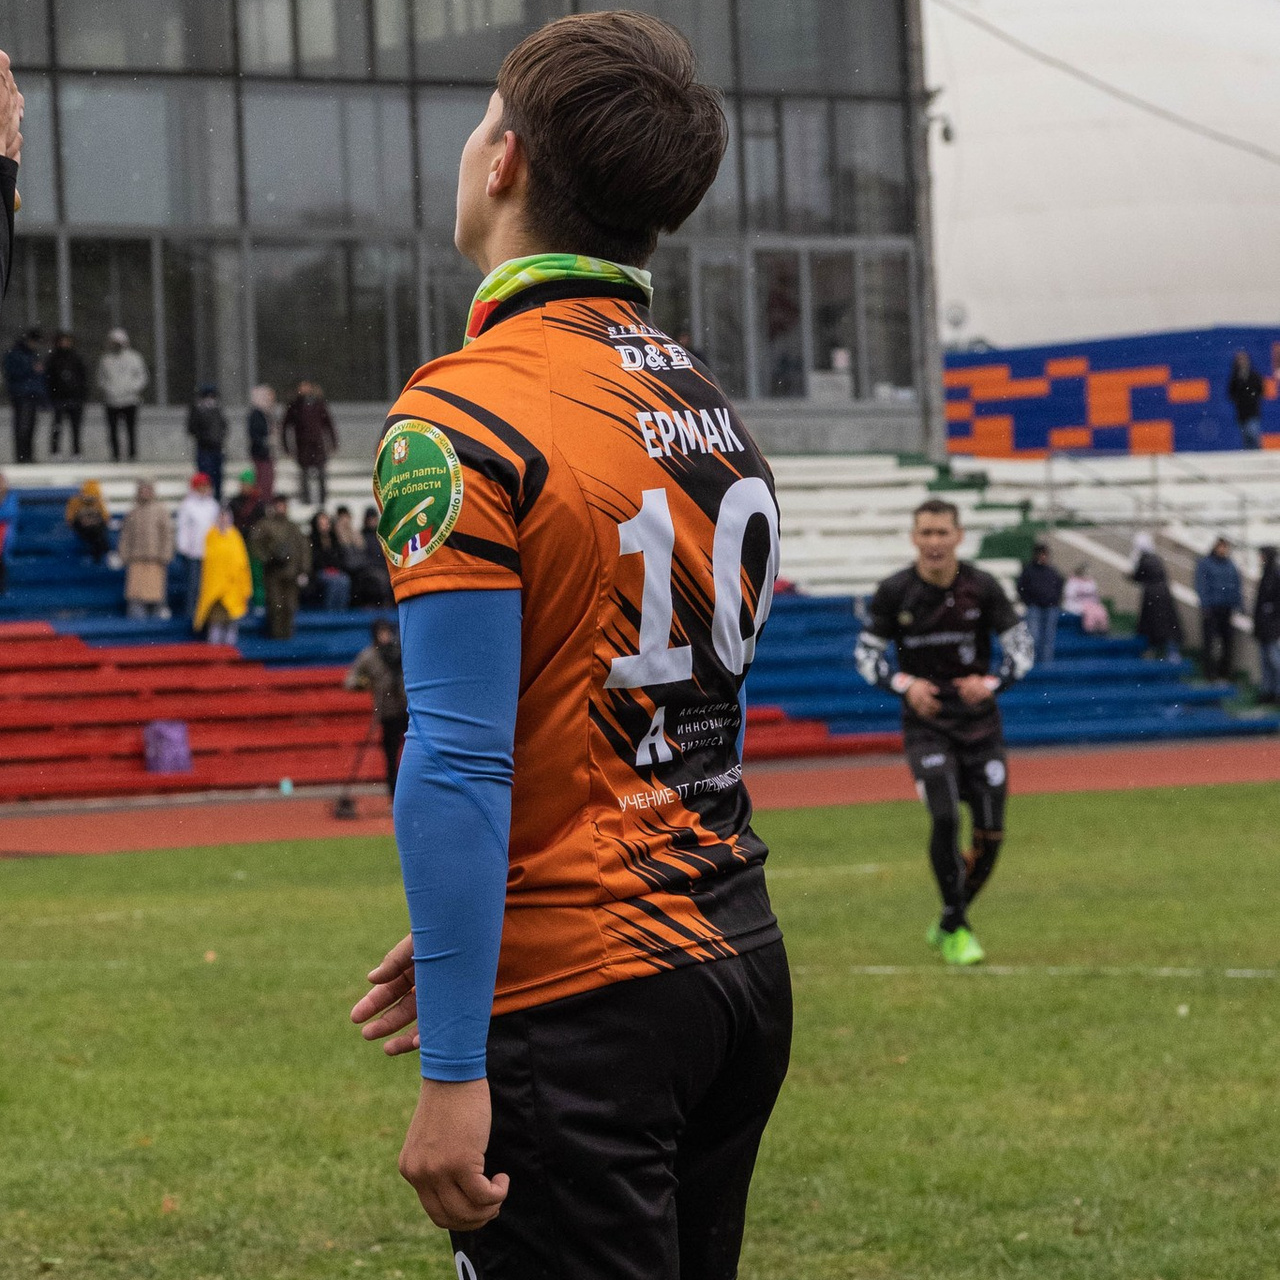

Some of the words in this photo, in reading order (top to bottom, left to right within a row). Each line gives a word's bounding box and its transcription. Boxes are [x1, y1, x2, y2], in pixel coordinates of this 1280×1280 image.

[615, 343, 693, 371] D&E
[636, 407, 745, 458] ЕРМАК
[412, 466, 446, 478] лапты
[401, 481, 442, 496] области
[424, 498, 462, 555] организация
[603, 477, 781, 689] 10
[676, 783, 690, 801] IT
